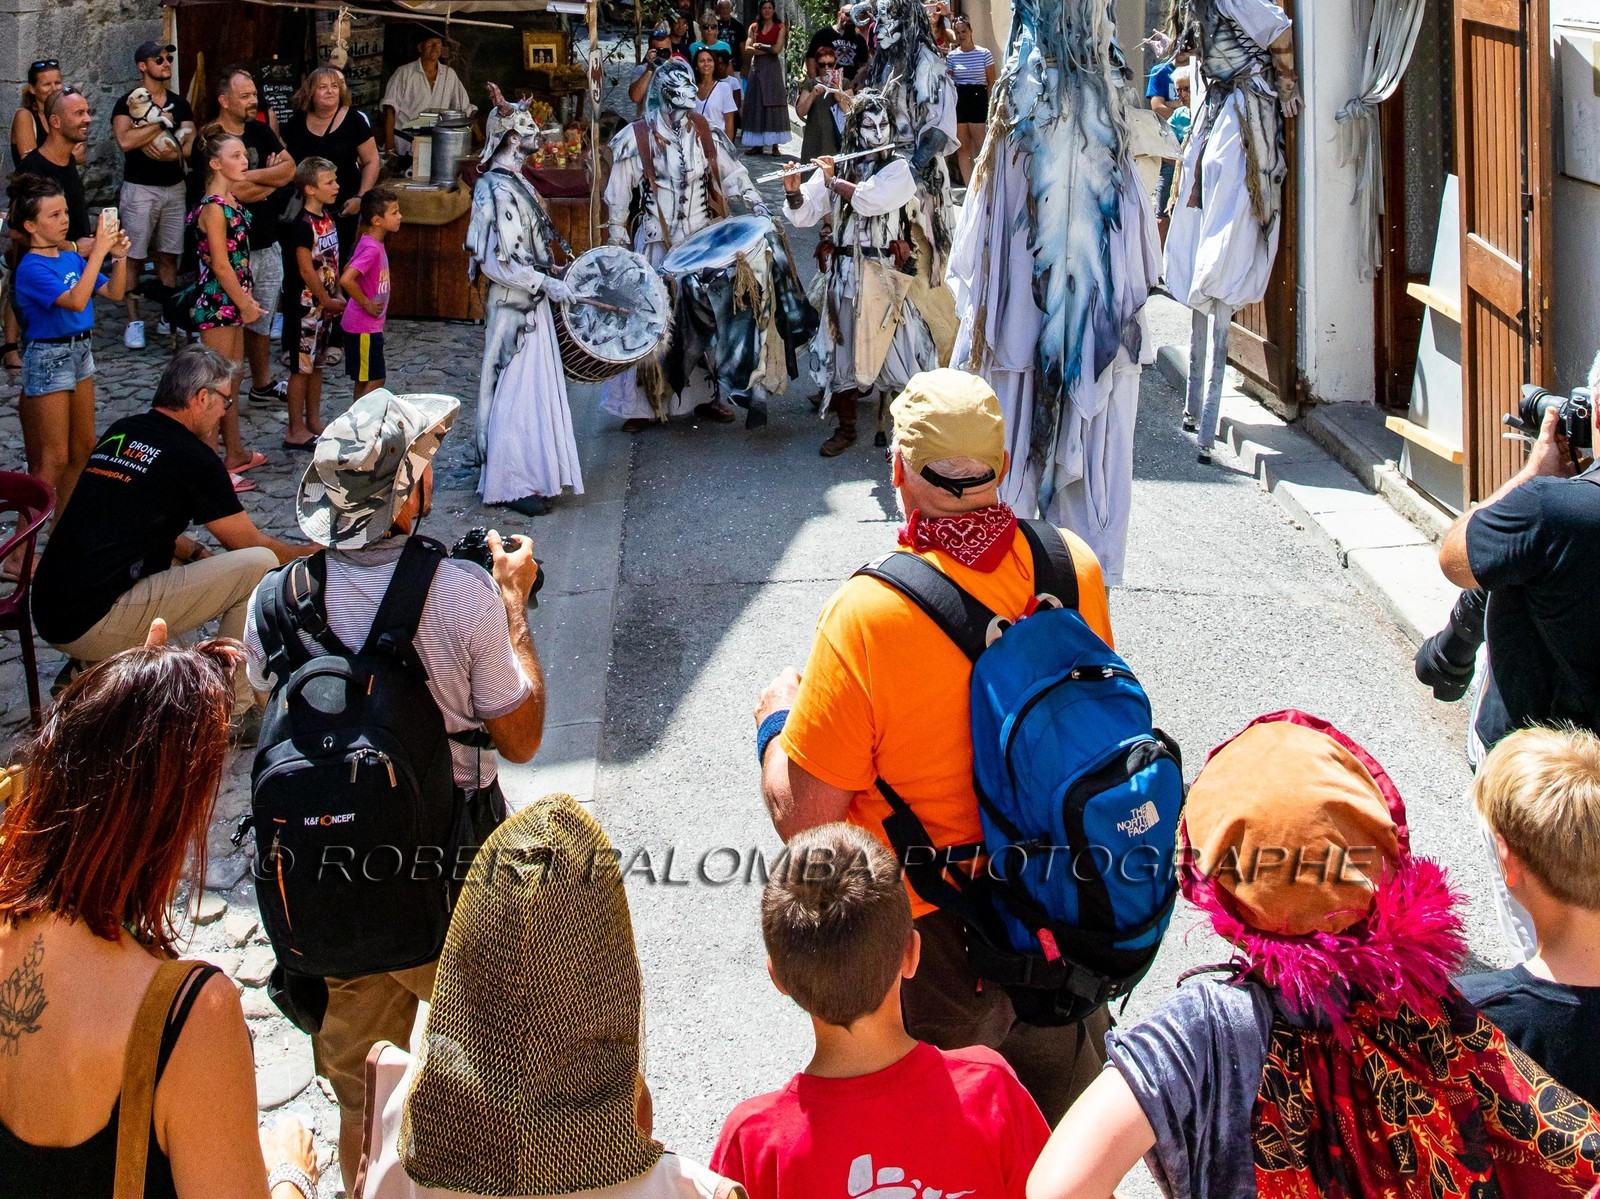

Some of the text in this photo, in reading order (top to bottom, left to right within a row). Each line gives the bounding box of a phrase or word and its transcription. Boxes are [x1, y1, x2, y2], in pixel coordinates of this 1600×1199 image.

[123, 448, 154, 465] ALP04
[129, 440, 161, 458] DRONE
[1130, 803, 1147, 818] THE
[304, 816, 319, 826] K&F
[1116, 815, 1149, 832] NORTH
[1127, 824, 1149, 838] FACE
